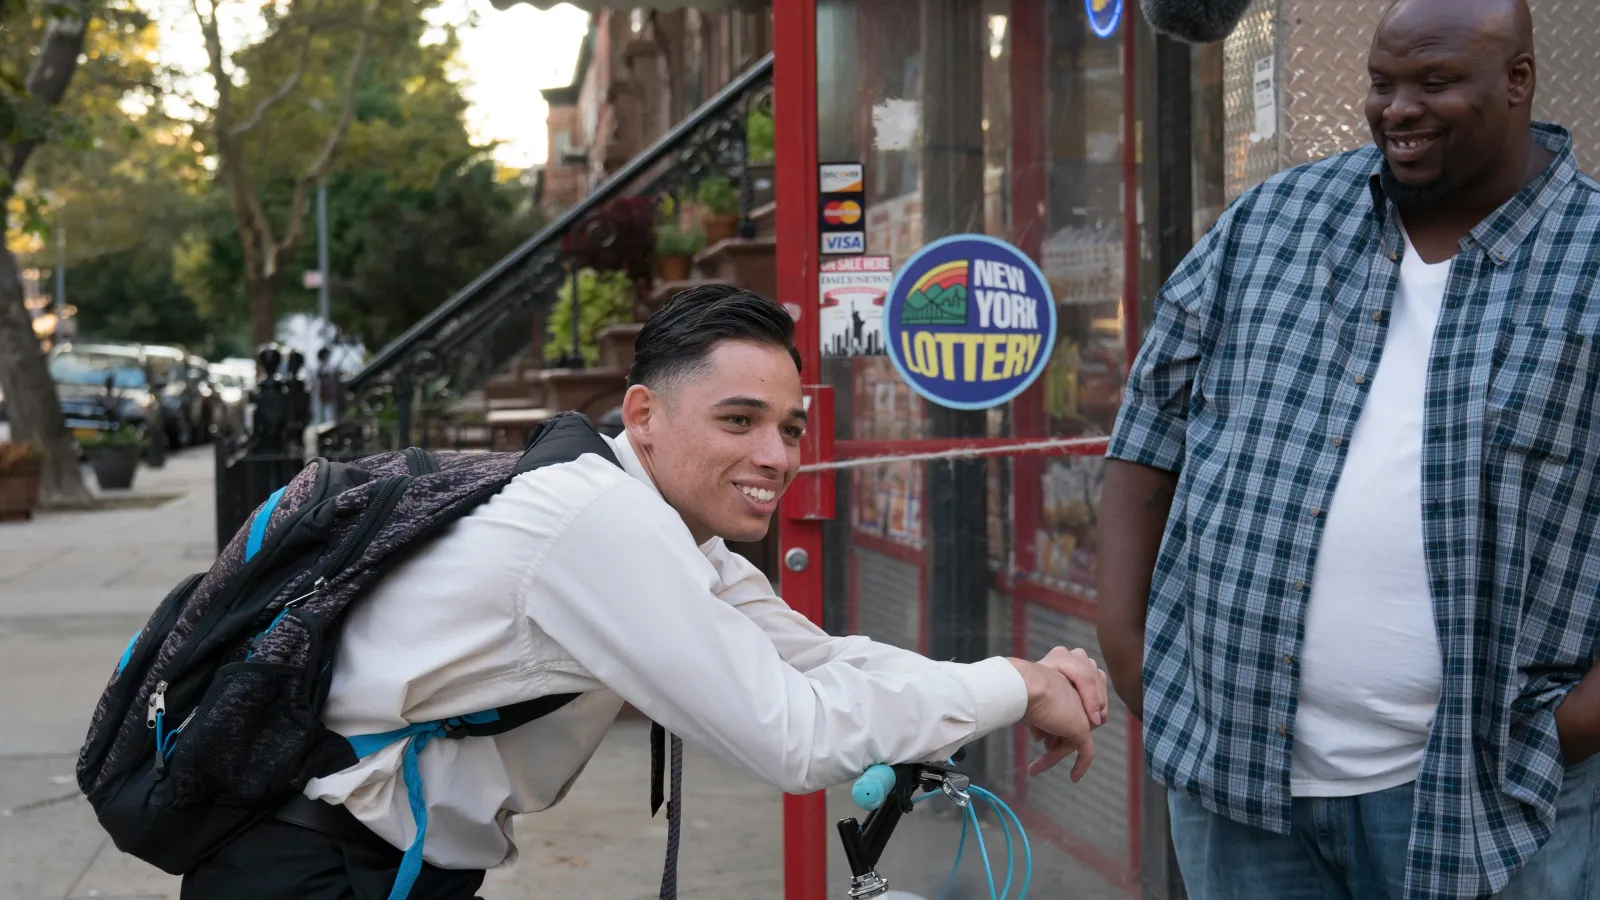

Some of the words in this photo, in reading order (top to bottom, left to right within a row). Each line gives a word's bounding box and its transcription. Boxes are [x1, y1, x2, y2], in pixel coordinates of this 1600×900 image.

[825, 236, 862, 249] VISA
[836, 257, 863, 271] SALE
[863, 256, 891, 271] HERE
[820, 276, 854, 285] DAILY
[856, 275, 890, 285] NEWS
[974, 259, 1026, 293] NEW
[975, 290, 1038, 329] YORK
[901, 330, 1042, 382] LOTTERY
